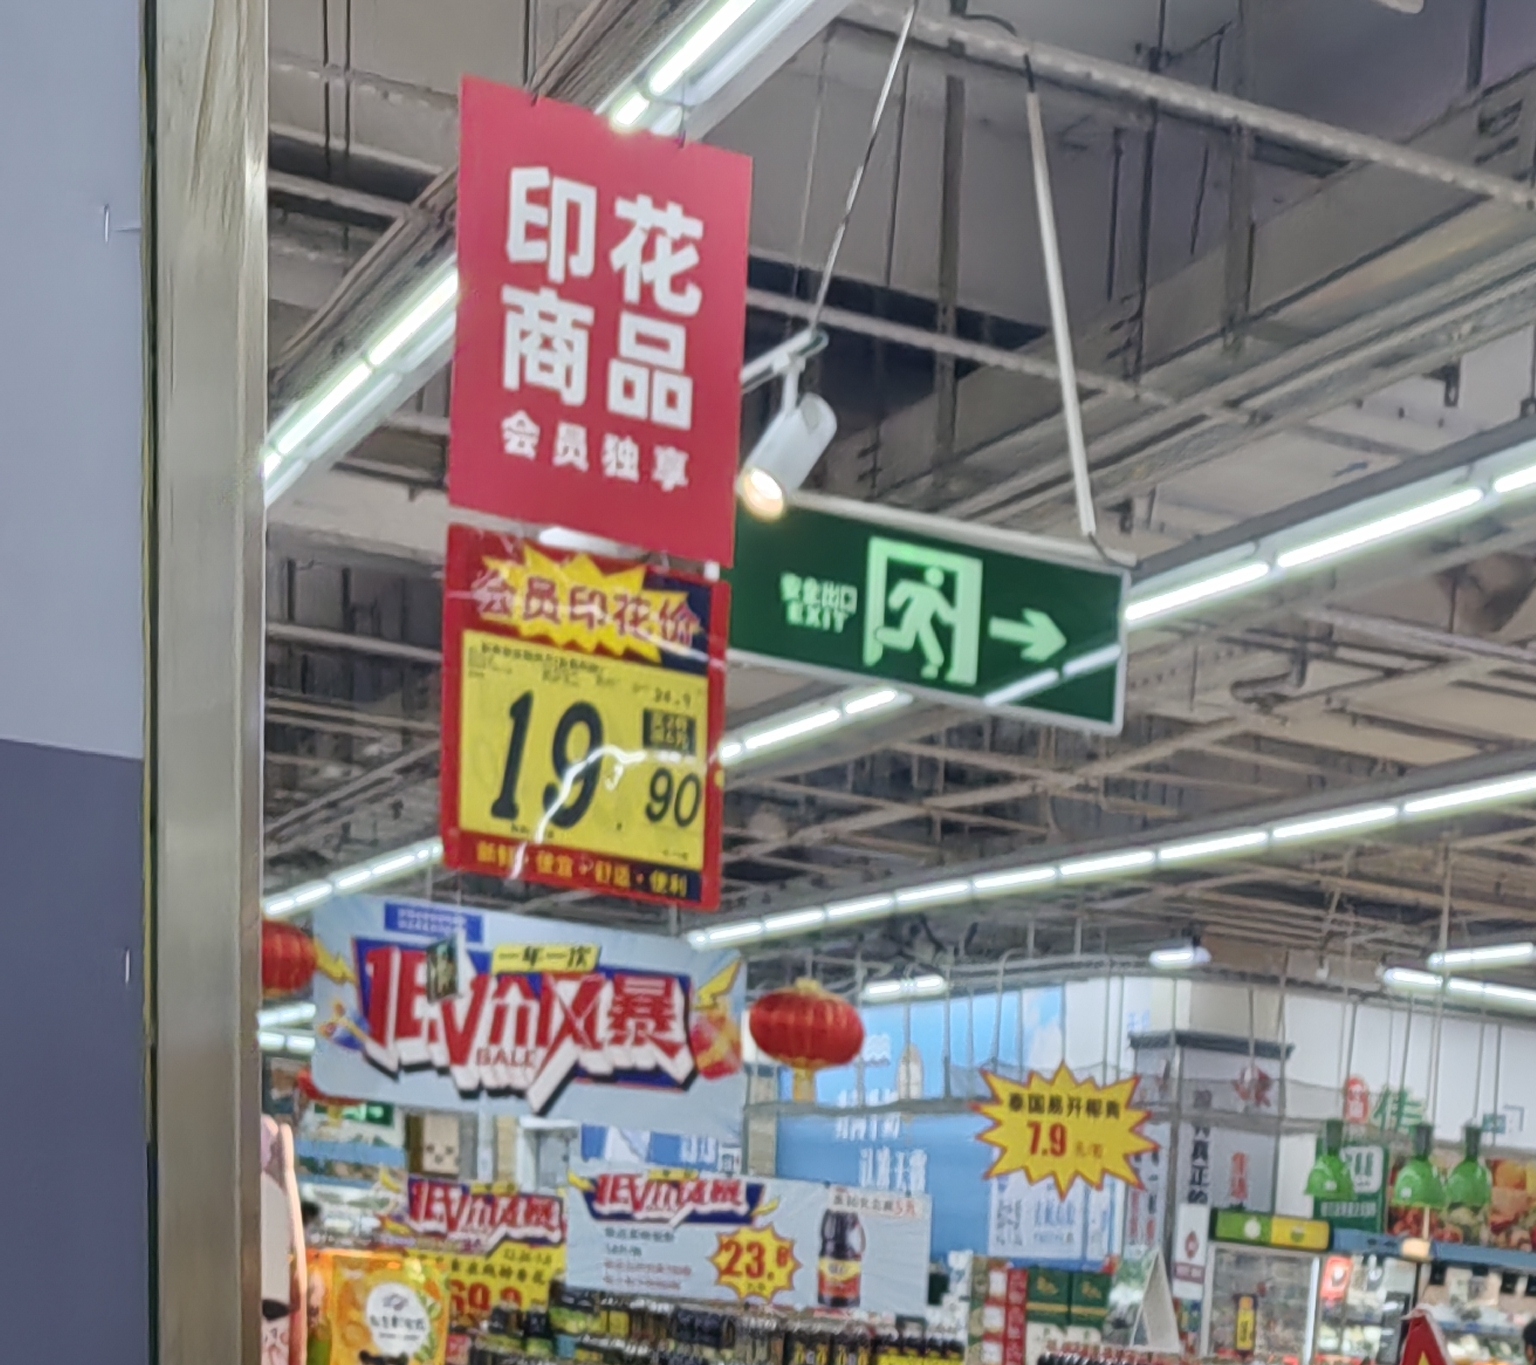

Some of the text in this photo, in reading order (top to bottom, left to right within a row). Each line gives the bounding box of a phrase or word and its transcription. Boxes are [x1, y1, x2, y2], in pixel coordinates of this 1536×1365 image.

[505, 166, 704, 318] 印花
[500, 283, 693, 431] 商品
[501, 411, 690, 491] 会员独享
[471, 570, 704, 650] 会员印花价
[786, 601, 848, 634] EXIT
[490, 690, 605, 830] 19
[645, 767, 703, 829] 90
[498, 945, 595, 970] 一年一次
[1027, 1120, 1067, 1158] 7.9
